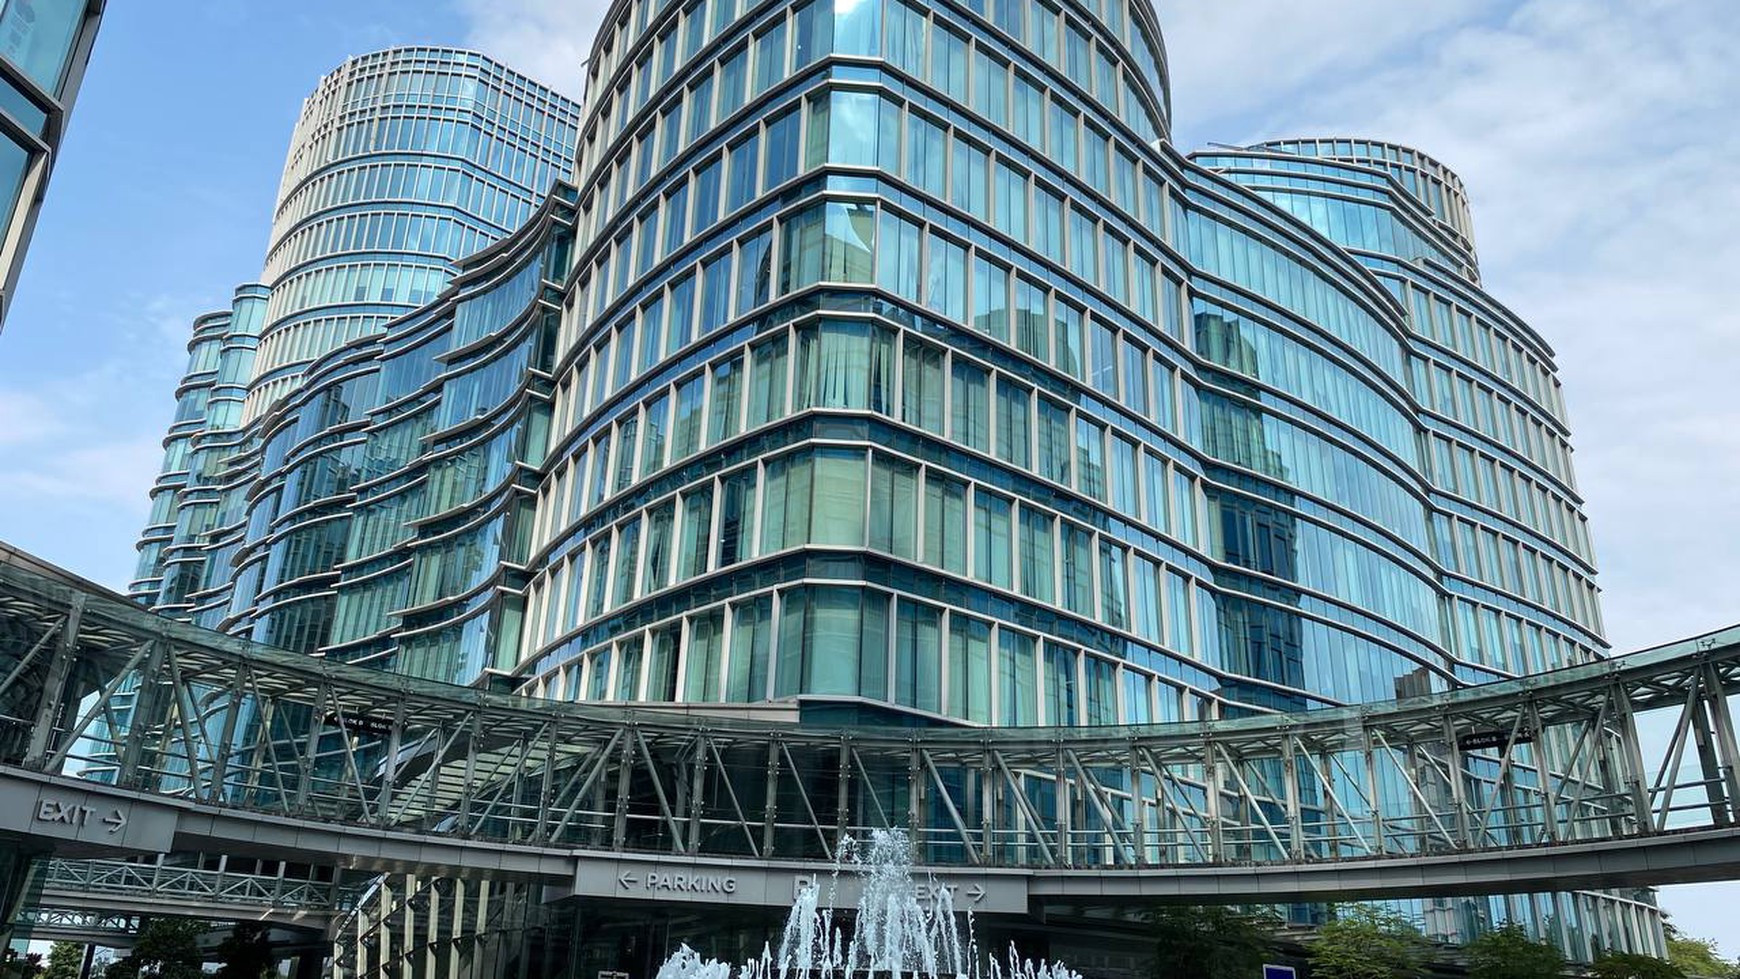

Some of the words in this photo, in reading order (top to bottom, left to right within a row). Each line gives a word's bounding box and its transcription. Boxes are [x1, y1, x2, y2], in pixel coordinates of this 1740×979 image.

[38, 800, 96, 826] EXIT
[646, 872, 737, 893] PARKING
[915, 883, 958, 900] EXT
